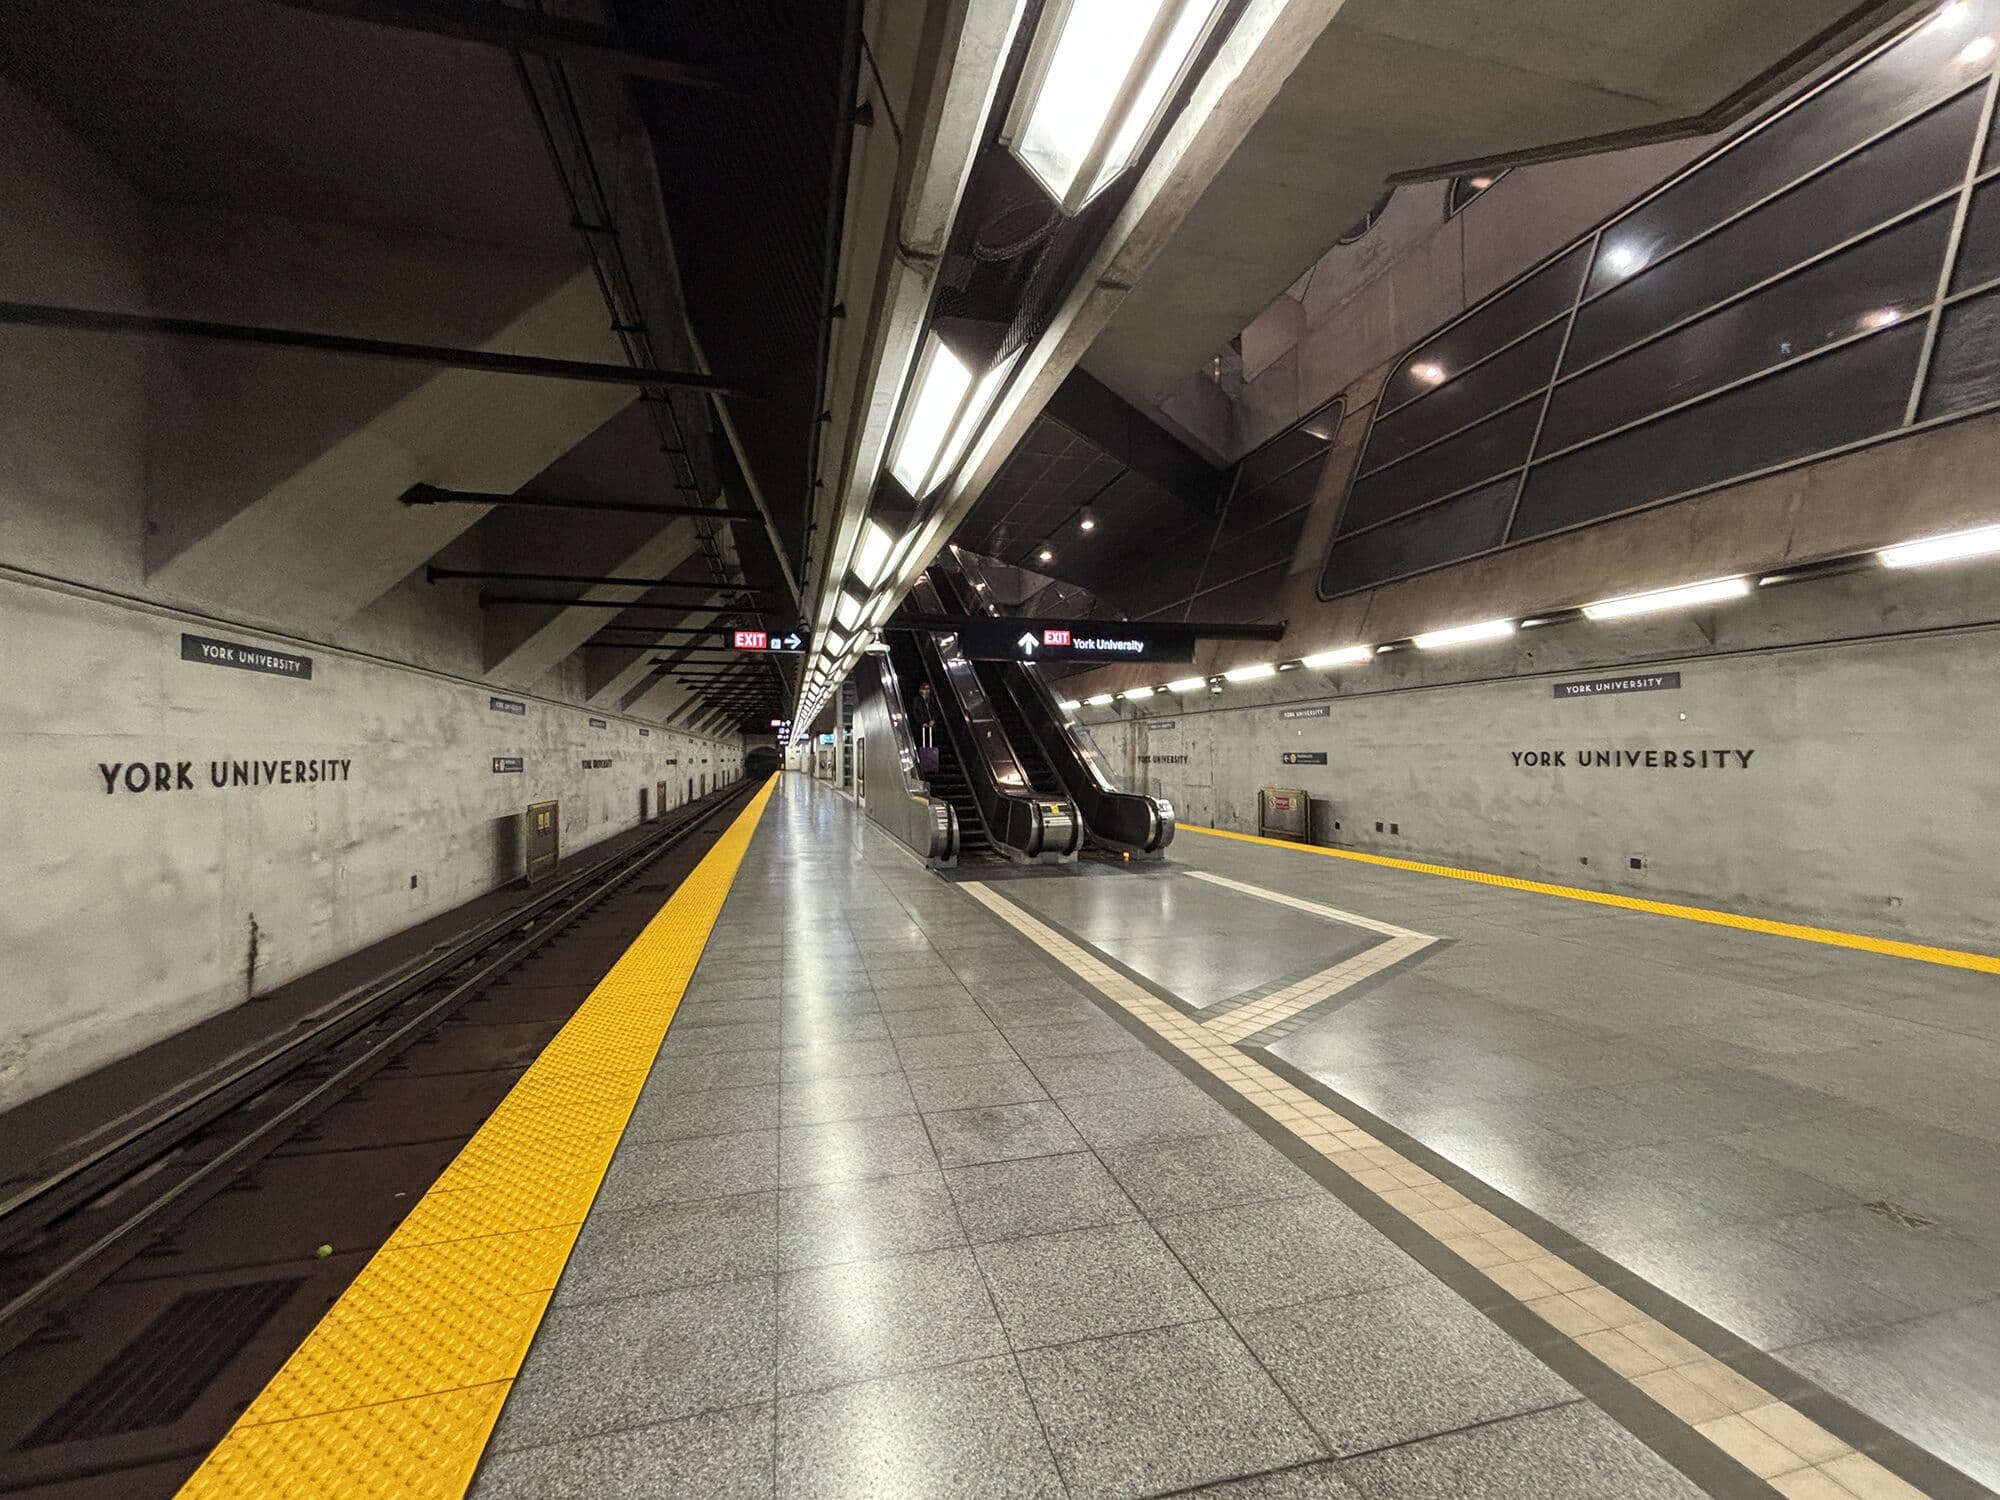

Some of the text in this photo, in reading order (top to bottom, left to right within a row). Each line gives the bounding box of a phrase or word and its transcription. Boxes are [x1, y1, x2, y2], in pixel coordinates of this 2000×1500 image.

[735, 632, 765, 647] EXIT
[1045, 630, 1144, 653] EXIT York University
[201, 644, 301, 672] YORK UNIVERSITY
[1566, 677, 1664, 694] YORK UNIVERSITY
[1511, 750, 1755, 769] YORK UNIVERSITY
[98, 759, 351, 794] YORK UNIVERSITY
